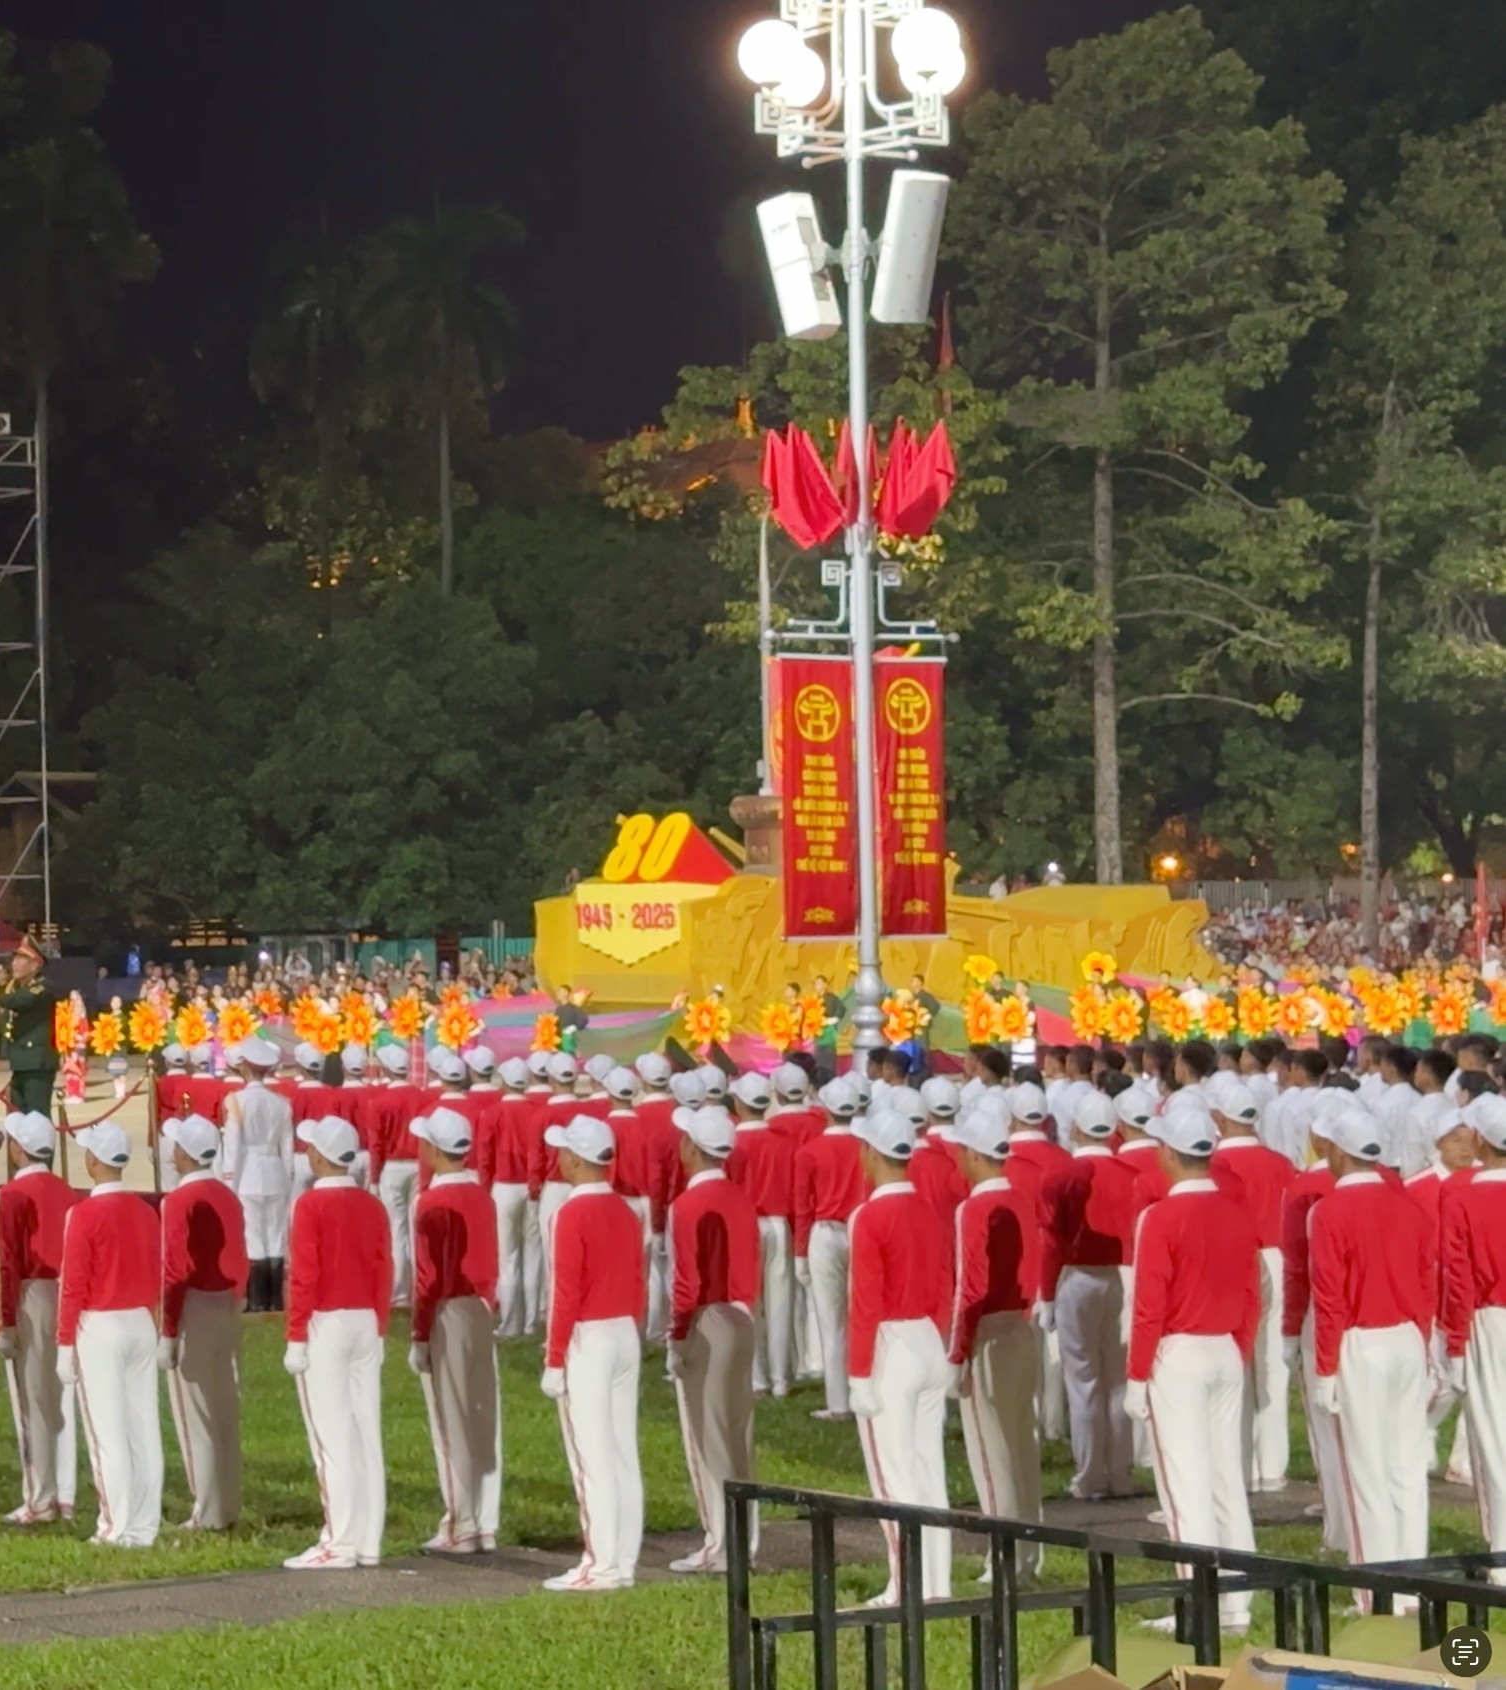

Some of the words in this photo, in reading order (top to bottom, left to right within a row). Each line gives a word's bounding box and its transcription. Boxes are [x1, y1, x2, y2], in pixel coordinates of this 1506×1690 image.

[603, 812, 691, 882] 80
[575, 903, 613, 930] 1945
[631, 903, 676, 930] 2025
